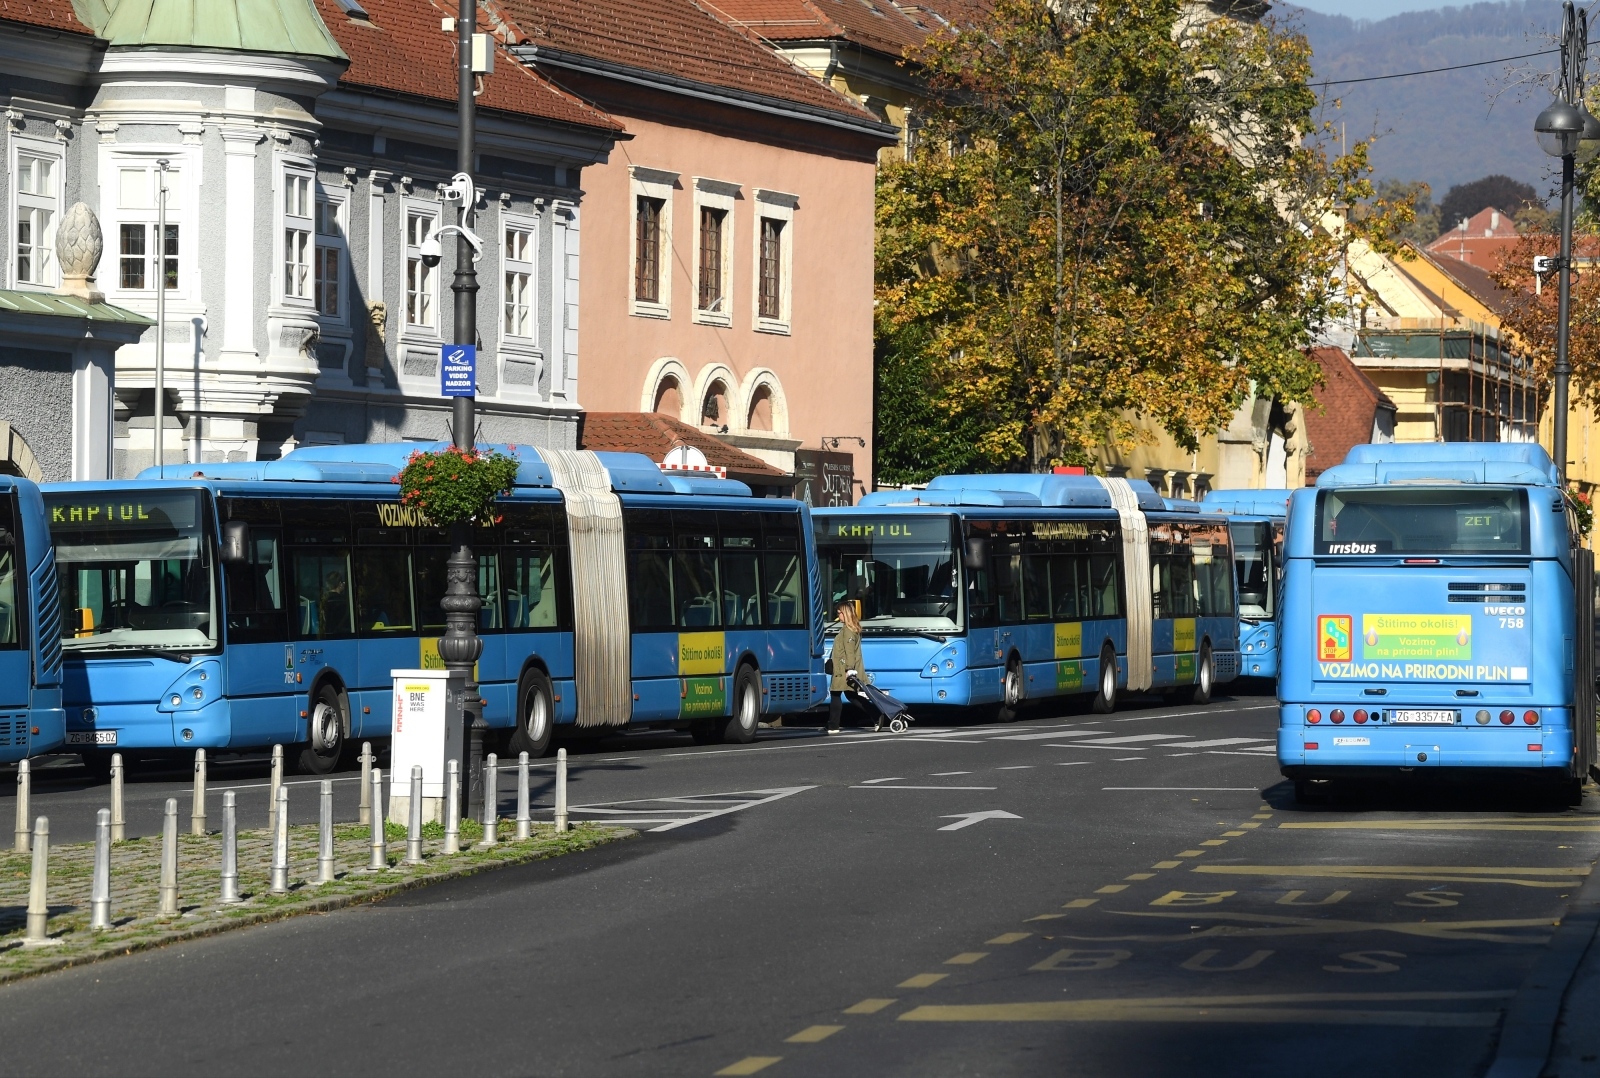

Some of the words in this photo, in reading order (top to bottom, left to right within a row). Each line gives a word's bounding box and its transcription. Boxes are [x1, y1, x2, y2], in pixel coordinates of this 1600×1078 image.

[1464, 516, 1492, 526] ZET
[1329, 542, 1377, 555] irisbus
[1484, 606, 1525, 616] IVECO
[1377, 616, 1417, 628] Štitimo
[1421, 618, 1458, 628] okoliš!
[1498, 618, 1524, 629] 758
[1399, 637, 1436, 646] Vozimo
[681, 644, 702, 661] Štitimo
[704, 646, 723, 660] okoliš!
[1392, 647, 1432, 657] prirodni
[1436, 648, 1458, 657] plin!
[284, 671, 295, 684] 762
[1320, 663, 1379, 678] VOZIMO
[1381, 664, 1401, 678] NA
[1405, 664, 1473, 680] PRIRODNI
[1477, 666, 1508, 681] PLIN
[694, 683, 713, 695] Vozimo
[410, 692, 425, 702] BNE
[1397, 711, 1409, 721] ZG
[70, 733, 80, 743] ZG
[1148, 889, 1466, 908] BUS
[1026, 948, 1407, 974] BUS
